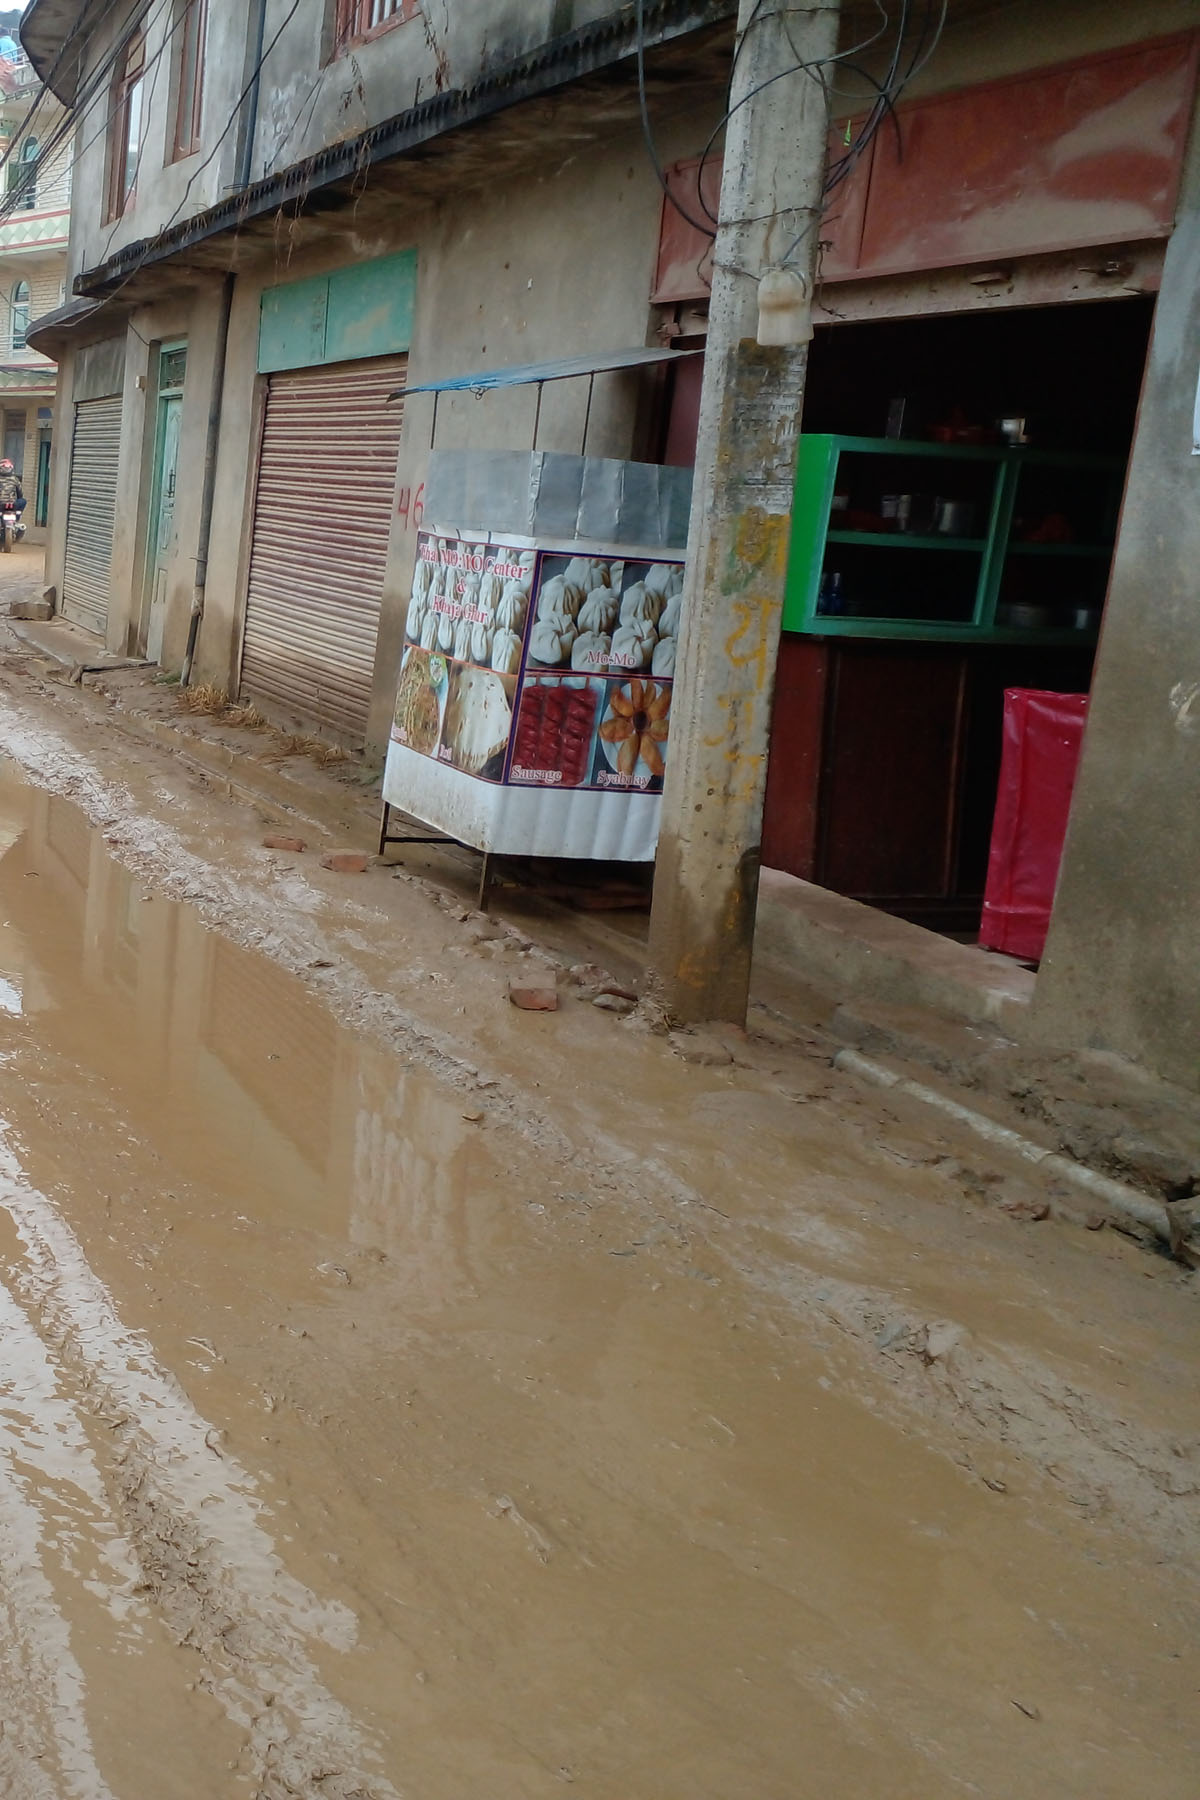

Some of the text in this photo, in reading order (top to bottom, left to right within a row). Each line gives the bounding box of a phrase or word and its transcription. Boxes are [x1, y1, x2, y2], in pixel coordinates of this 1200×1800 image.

[484, 556, 529, 579] Center
[456, 576, 466, 594] &
[586, 650, 636, 667] Mo:Mo
[511, 764, 563, 784] Sausage
